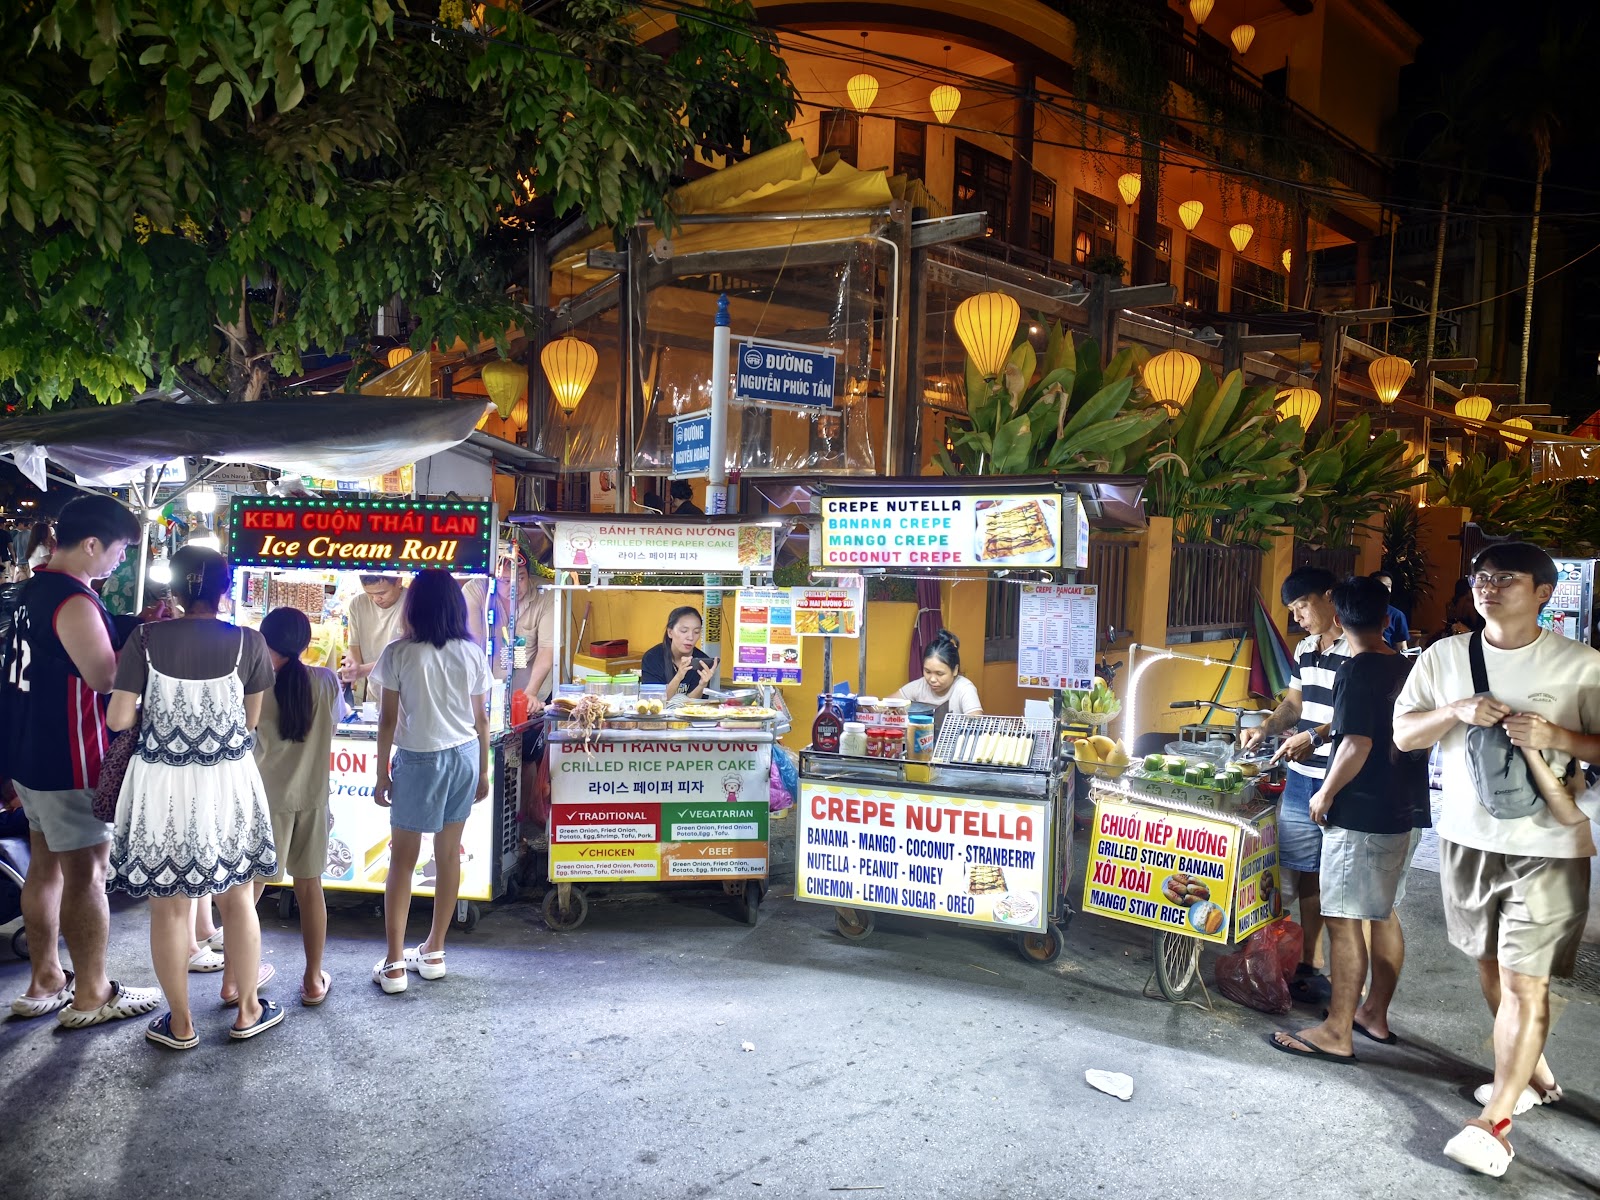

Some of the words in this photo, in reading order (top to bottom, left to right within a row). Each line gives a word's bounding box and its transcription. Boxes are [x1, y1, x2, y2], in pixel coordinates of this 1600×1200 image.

[766, 353, 813, 374] ĐƯỜNG
[741, 372, 780, 392] NGUYỄN
[783, 379, 810, 396] PHÚC
[684, 423, 704, 442] ĐƯỜNG
[676, 446, 692, 465] NGUYỄN
[829, 502, 878, 512] CREPE
[887, 500, 961, 512] NUTELLA
[244, 511, 295, 530] KEM
[302, 509, 362, 536] CUỘN
[368, 511, 424, 533] THÁI
[431, 515, 477, 535] LAN
[600, 525, 636, 536] BÁNH
[641, 526, 683, 536] TRÁNG
[686, 526, 736, 537] NƯỚNG
[830, 518, 891, 529] BANANA
[900, 518, 951, 528] CREPE
[259, 535, 299, 556] Ice
[308, 536, 392, 559] Cream
[399, 539, 457, 561] Roll
[830, 535, 886, 546] MANGO
[895, 535, 948, 546] CREPE
[618, 551, 646, 560] 라이스
[649, 551, 677, 560] 페이퍼
[680, 551, 698, 560] 피자
[830, 552, 901, 562] COCONUT
[910, 552, 962, 562] CREPE
[1056, 586, 1082, 594] PANCAKE
[561, 761, 624, 773] CRILLED
[628, 761, 662, 772] RICE
[666, 760, 713, 771] PAPER
[717, 760, 756, 771] CAKE
[588, 781, 629, 794] 라이스
[633, 780, 673, 794] 페이퍼
[678, 780, 704, 794] 피자
[578, 812, 647, 820] TRADITIONAL
[690, 810, 754, 818] VEGATARIAN
[811, 795, 895, 827] CREPE
[906, 805, 1033, 842] NUTELLA
[1101, 811, 1141, 840] CHUỐI
[1144, 818, 1172, 846] NẾP
[1176, 828, 1228, 858] NƯỚNG
[709, 848, 733, 856] BEEF
[808, 827, 849, 848] BANANA
[859, 832, 896, 854] MANGO
[906, 838, 955, 860] COCONUT
[966, 845, 1036, 870] STRANBERRY
[808, 852, 849, 874] NUTELLA
[859, 858, 899, 879] PEANUT
[910, 864, 943, 885] HONEY
[1098, 840, 1138, 862] GRILLED
[1140, 848, 1175, 870] STICKY
[1179, 856, 1224, 880] BANANA
[1093, 860, 1116, 886] XÔI
[1118, 866, 1151, 894] XOÀI
[807, 876, 853, 899] CINEMON
[863, 883, 898, 905] LEMON
[902, 888, 936, 909] SUGAR
[947, 894, 974, 915] OREO
[1090, 890, 1126, 912] MANGO
[1129, 899, 1158, 919] STIKY
[1160, 905, 1185, 925] RICE
